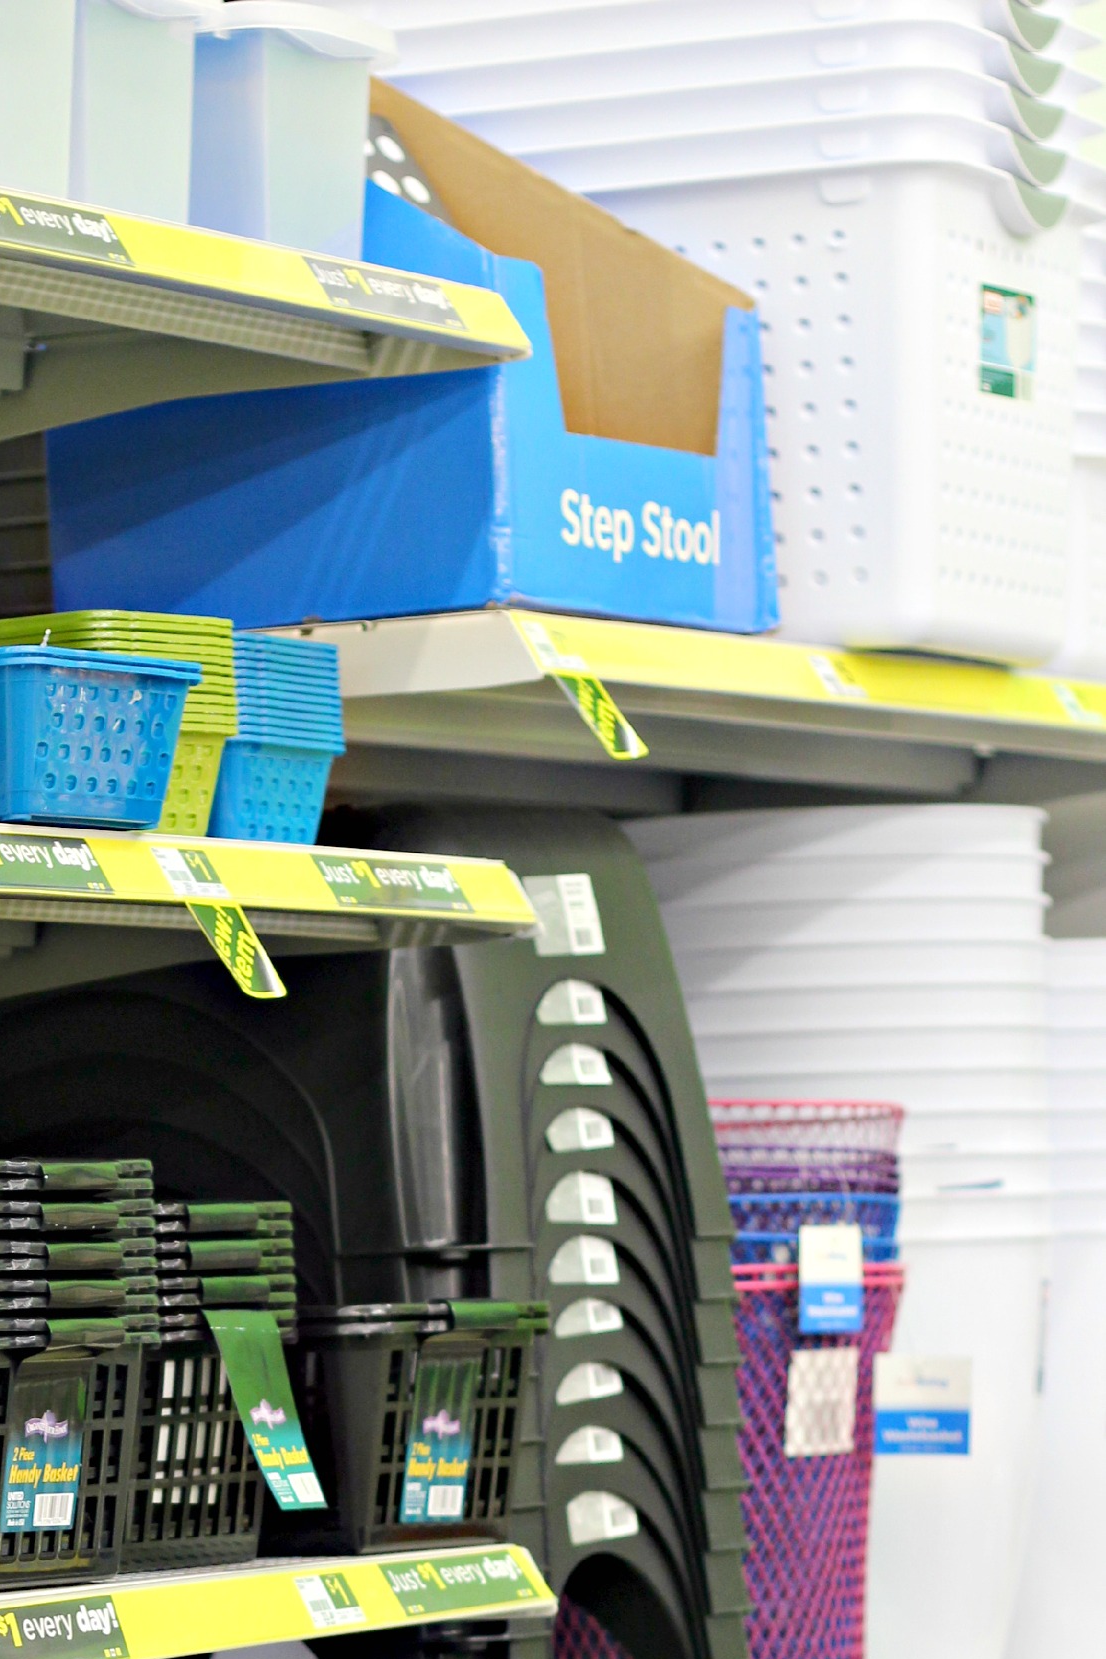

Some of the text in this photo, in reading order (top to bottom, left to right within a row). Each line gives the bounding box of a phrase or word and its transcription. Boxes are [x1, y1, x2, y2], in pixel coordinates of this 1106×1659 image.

[19, 206, 75, 236] every
[72, 213, 118, 242] day!
[311, 262, 353, 288] Just
[367, 277, 416, 304] every
[560, 488, 721, 566] Step Stool
[0, 843, 54, 869] every
[52, 841, 98, 871] day!
[184, 851, 212, 881] $1
[319, 860, 360, 884] Just
[374, 867, 423, 892] every
[419, 865, 459, 893] day!
[8, 1461, 80, 1488] Handy Basket
[387, 1555, 522, 1593] Just $1 every day!
[22, 1613, 73, 1641] every
[76, 1602, 119, 1635] day!
